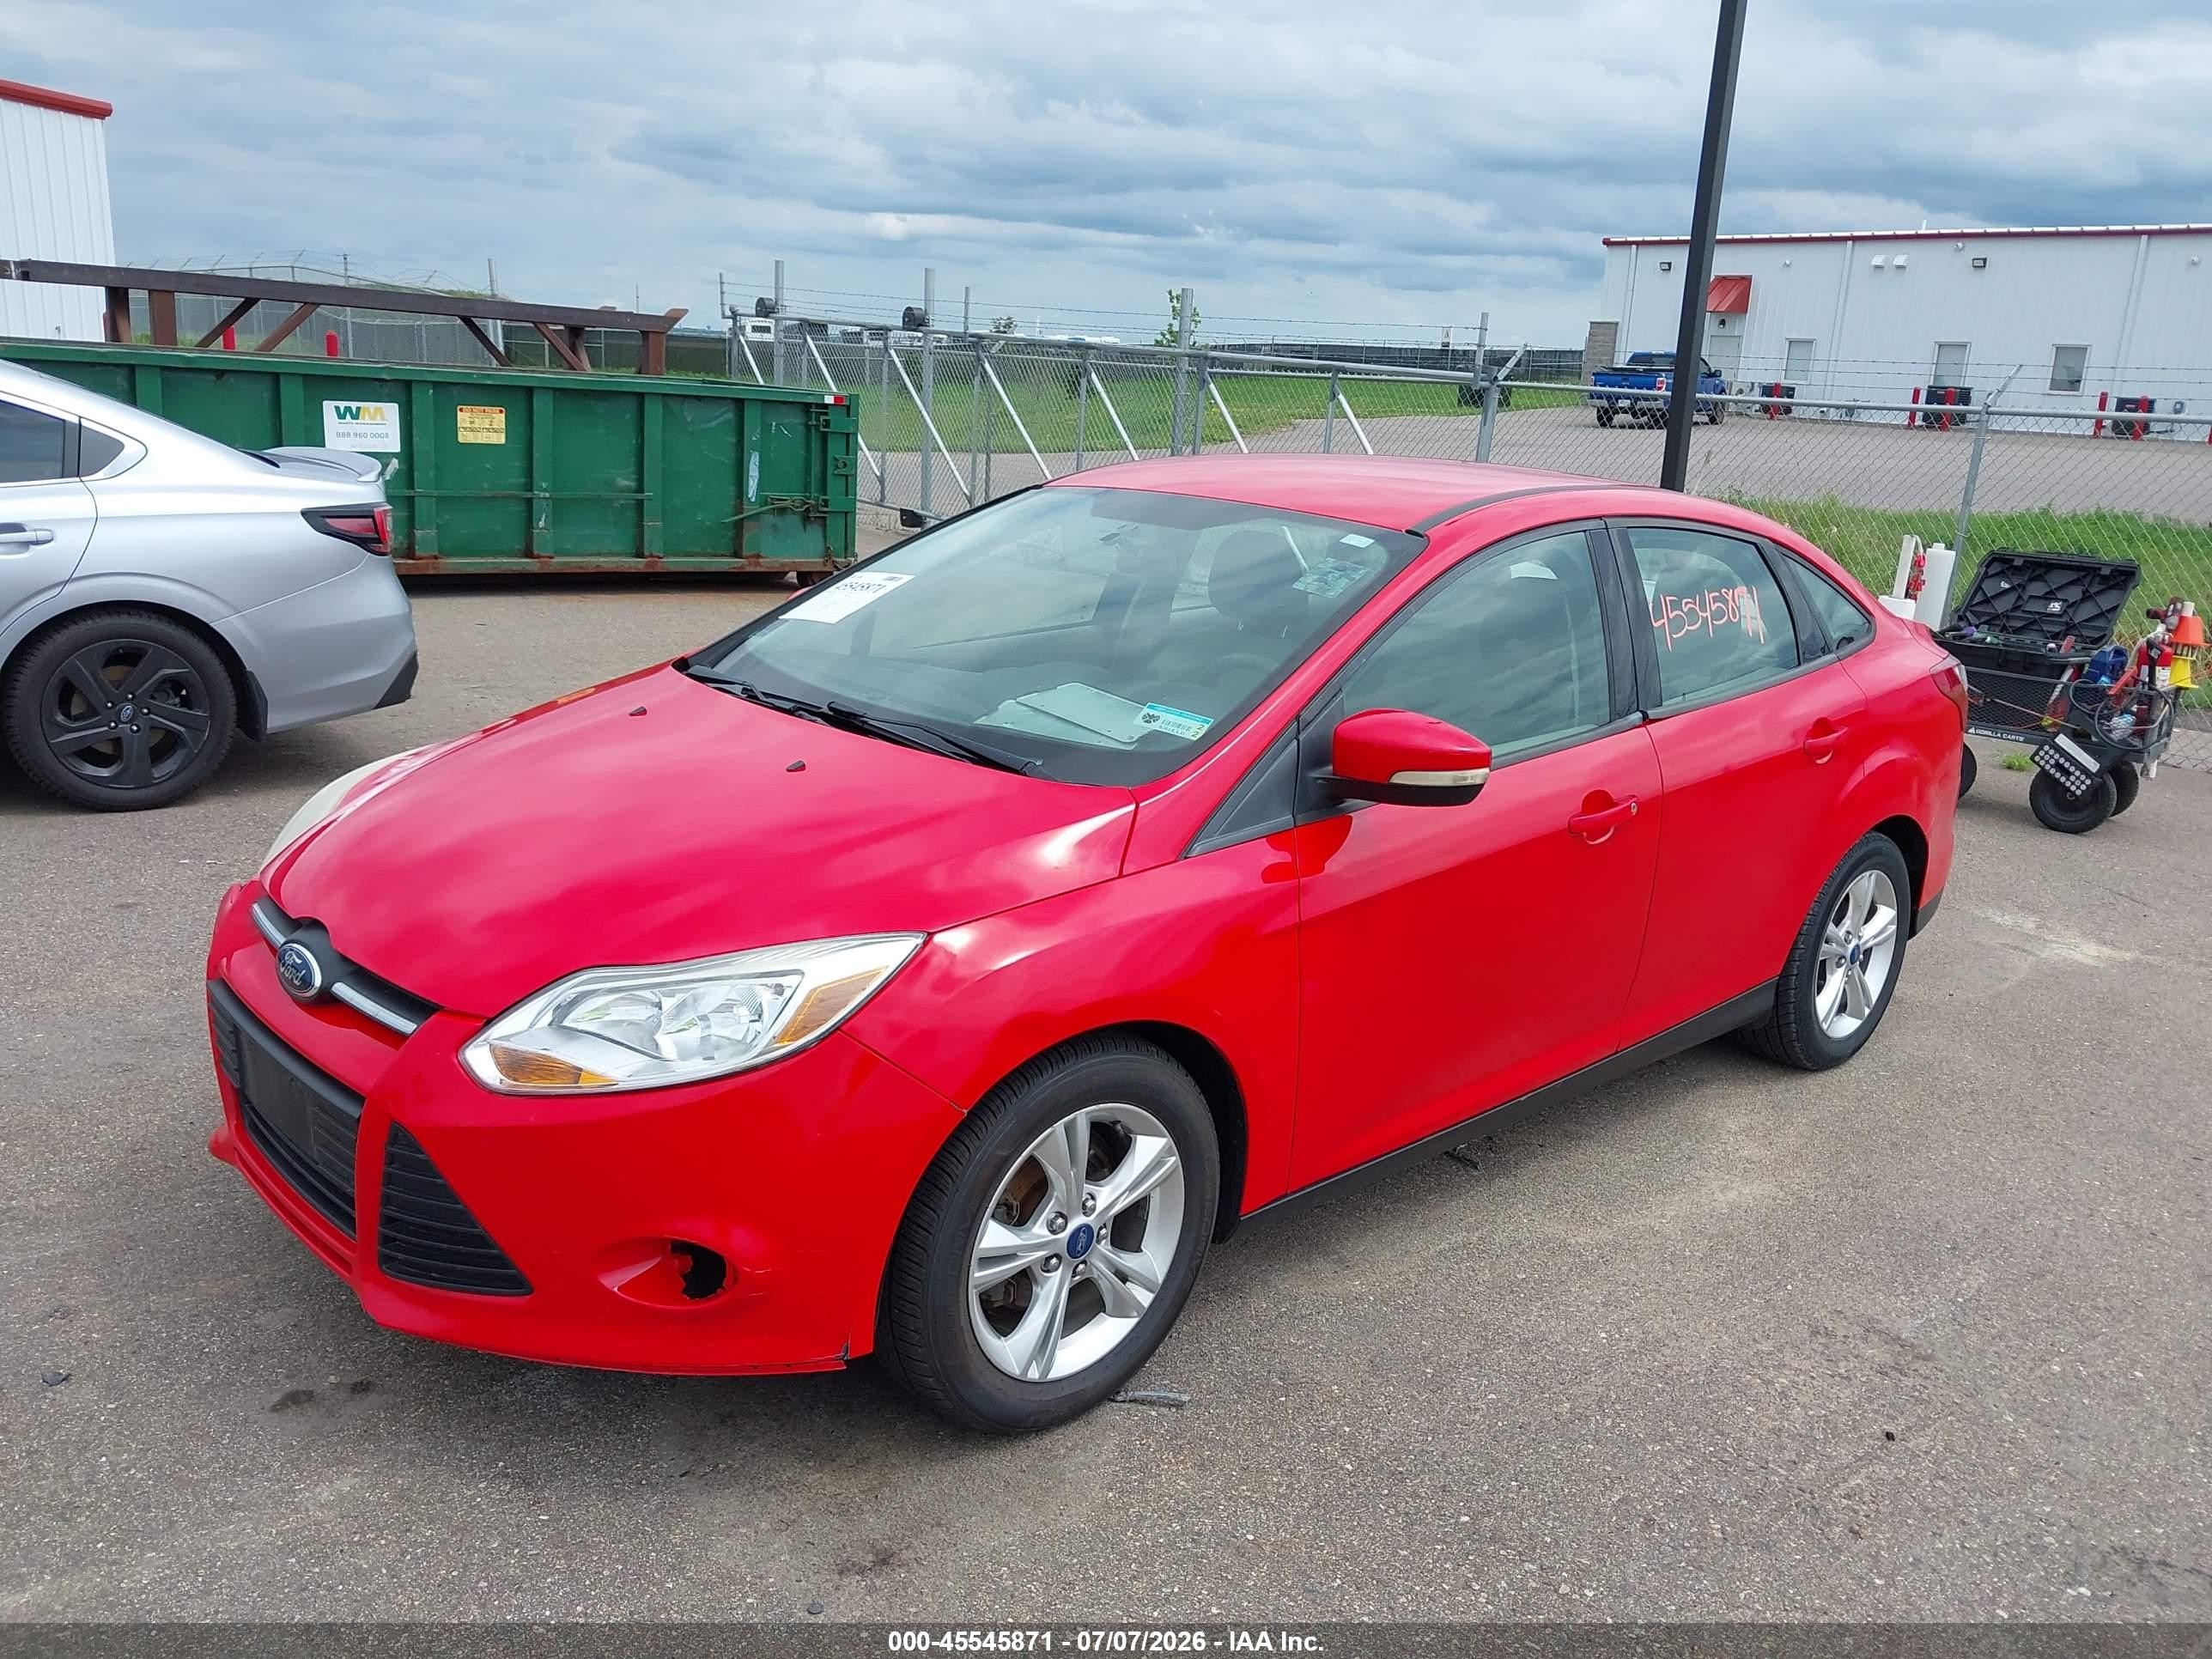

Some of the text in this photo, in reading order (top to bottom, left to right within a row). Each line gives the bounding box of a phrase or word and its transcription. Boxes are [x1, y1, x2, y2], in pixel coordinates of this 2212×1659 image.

[333, 405, 386, 421] WM
[1976, 729, 2001, 738] GORILLA
[280, 951, 306, 986] Ford
